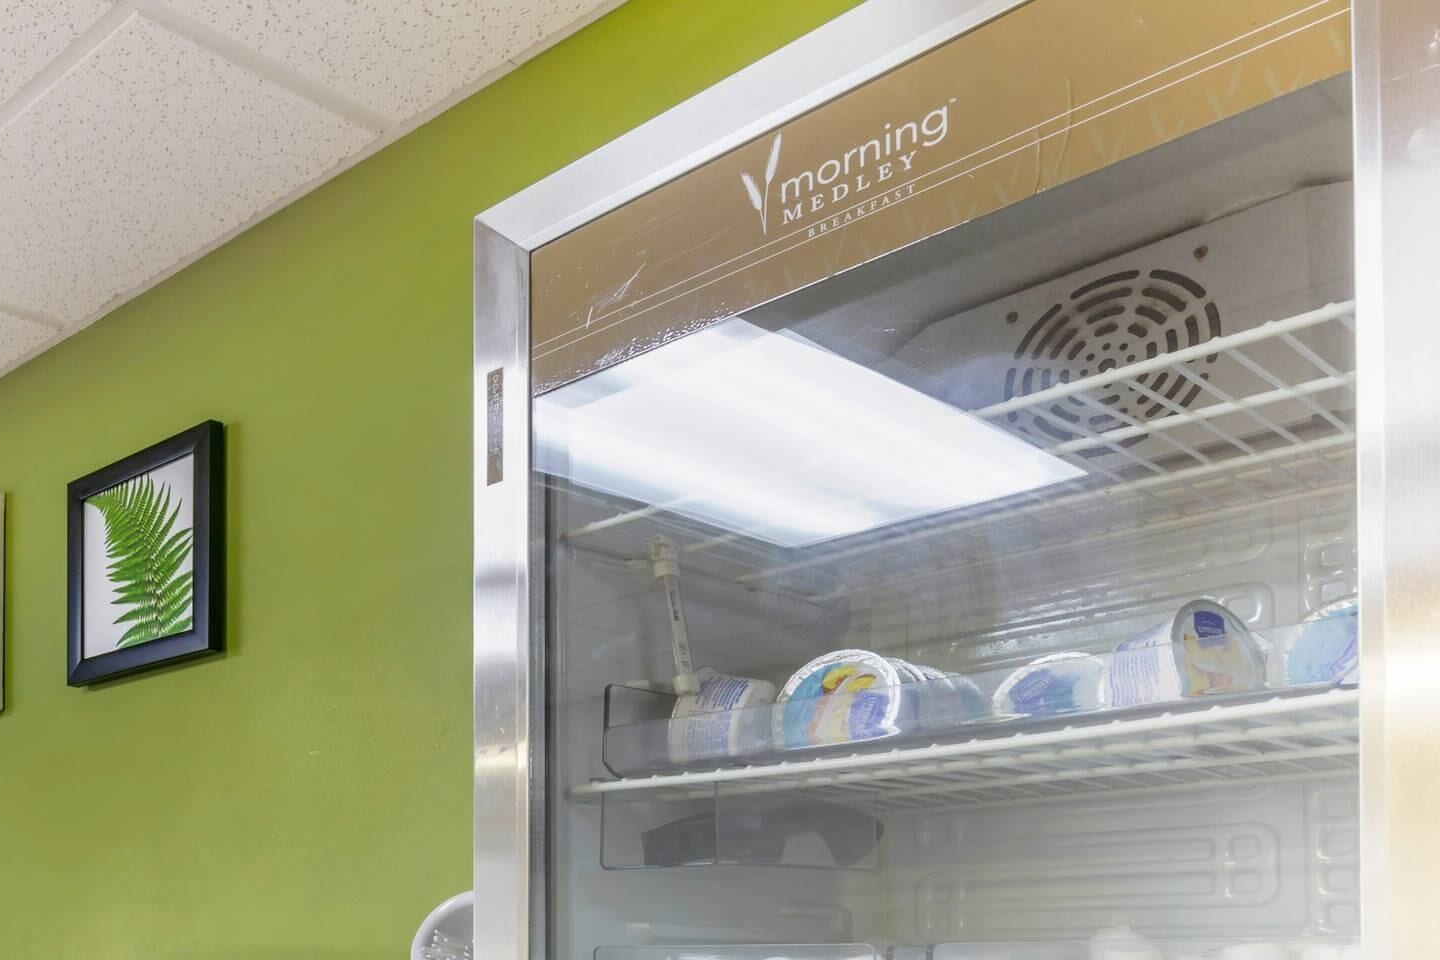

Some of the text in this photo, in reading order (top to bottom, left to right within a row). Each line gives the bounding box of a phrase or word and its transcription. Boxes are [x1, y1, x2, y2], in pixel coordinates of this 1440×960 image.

[781, 105, 948, 204] morning
[782, 150, 917, 225] MEDLEY
[808, 183, 916, 238] BREAKFAST
